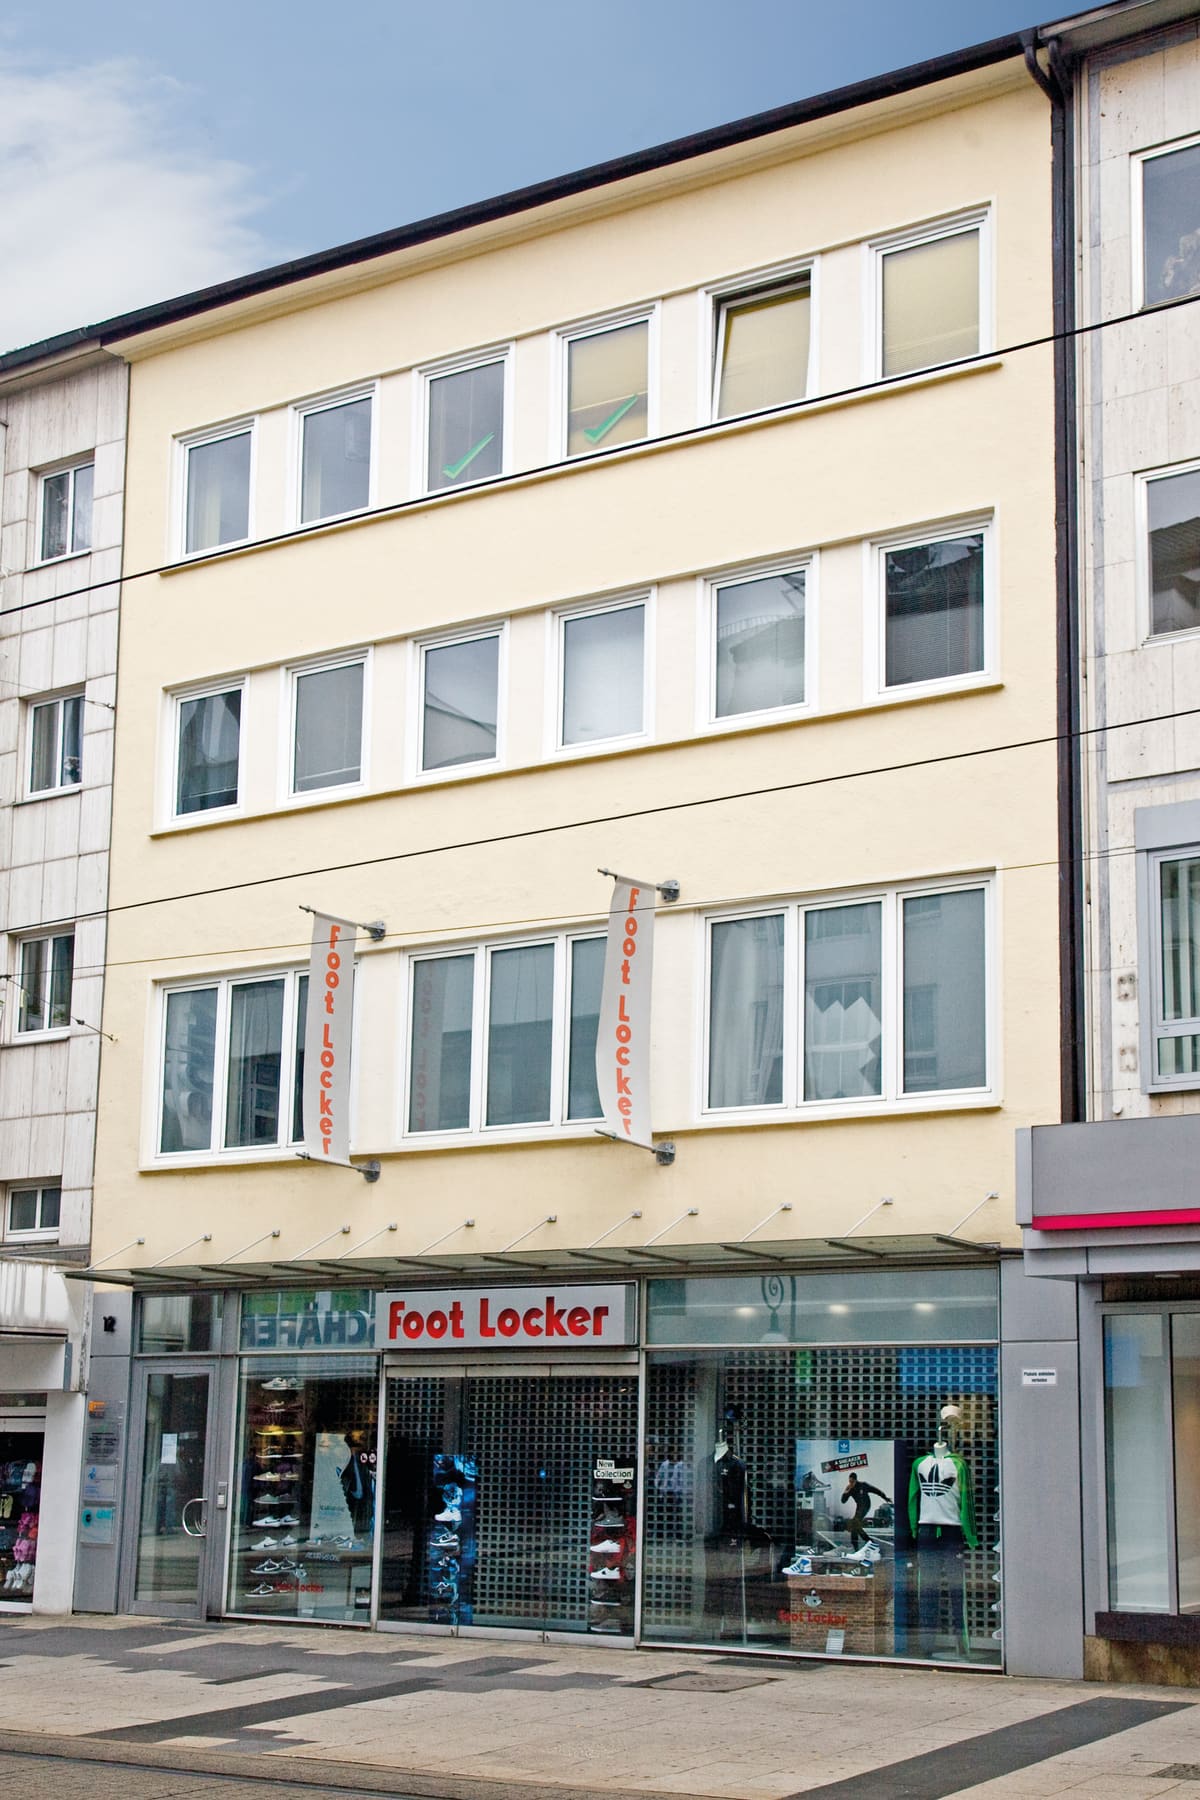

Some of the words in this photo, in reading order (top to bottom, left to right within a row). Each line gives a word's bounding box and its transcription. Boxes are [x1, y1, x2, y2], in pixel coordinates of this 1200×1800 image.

[324, 925, 340, 1014] Foot
[621, 887, 640, 984] Foot
[319, 1024, 335, 1155] Locker
[615, 995, 632, 1136] Locker
[103, 1316, 116, 1332] 12
[388, 1301, 465, 1339] Foot
[479, 1296, 609, 1338] Locker
